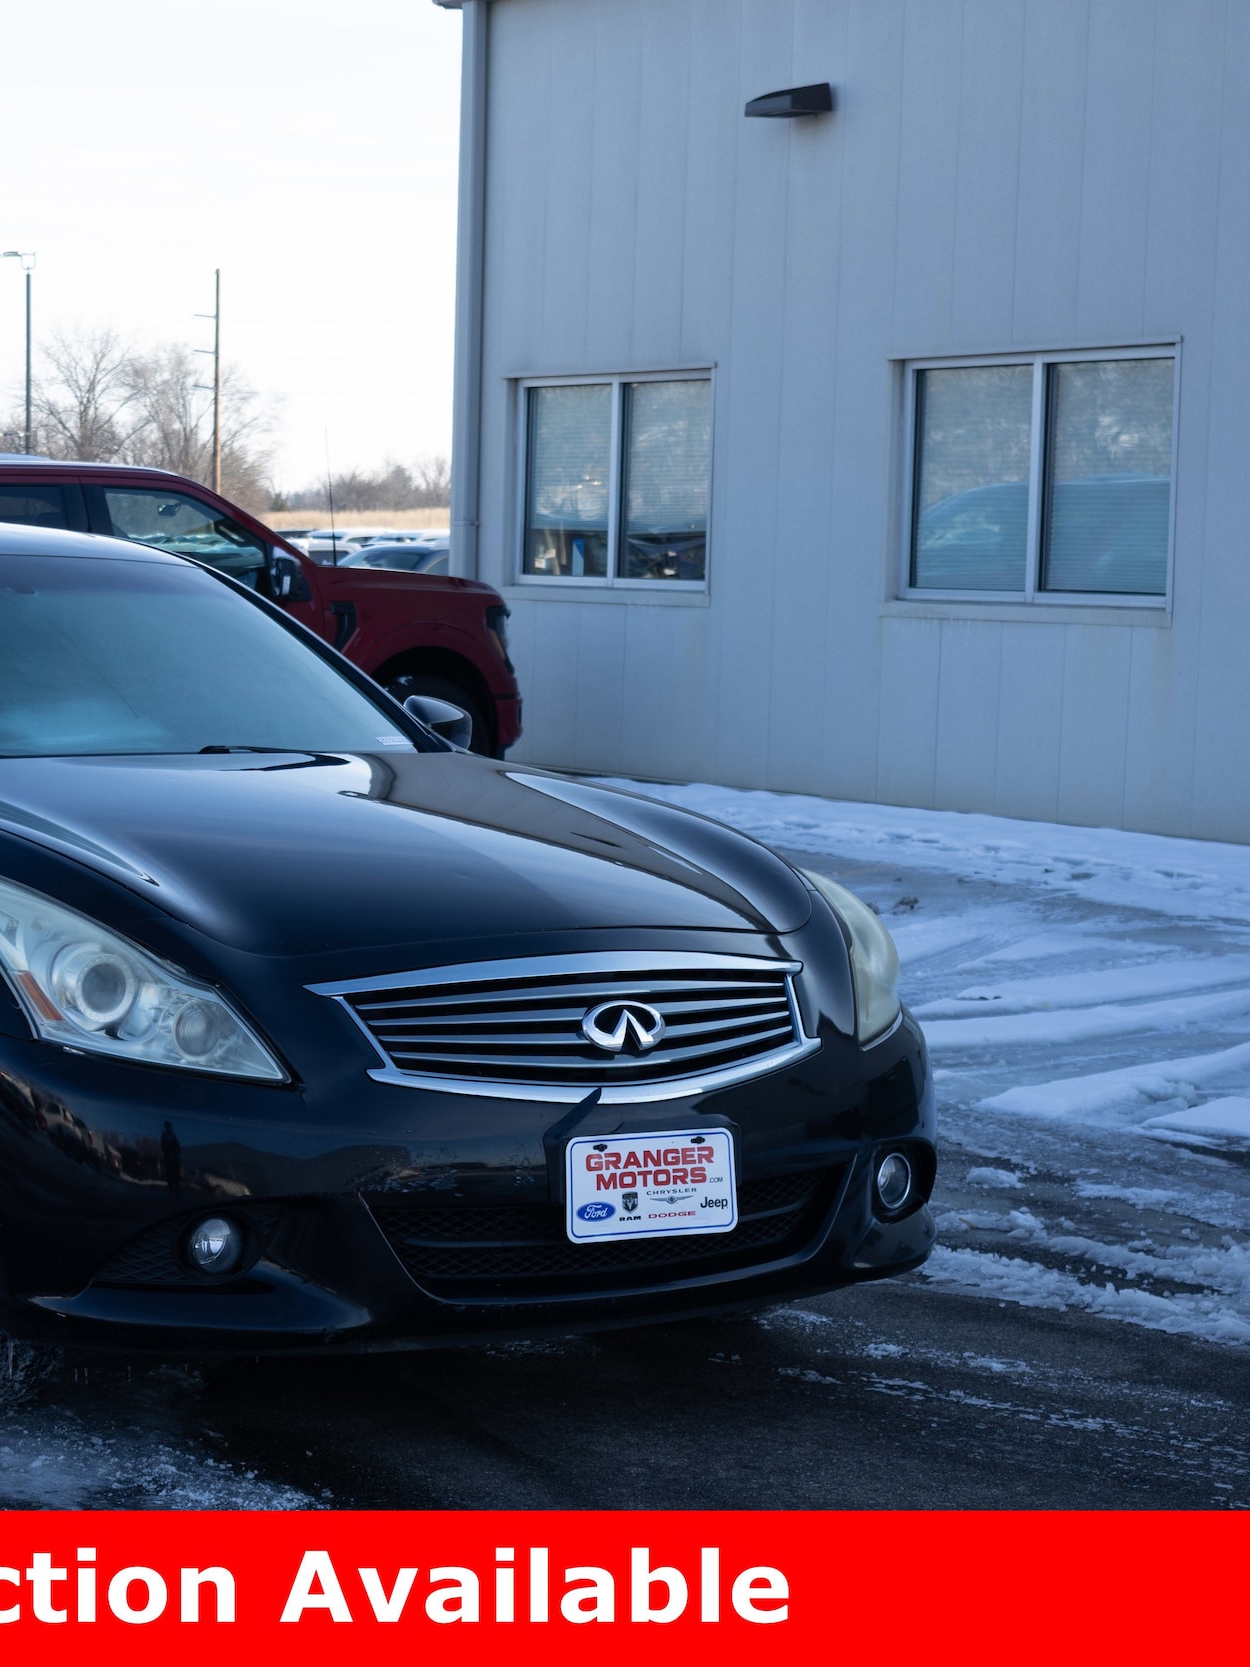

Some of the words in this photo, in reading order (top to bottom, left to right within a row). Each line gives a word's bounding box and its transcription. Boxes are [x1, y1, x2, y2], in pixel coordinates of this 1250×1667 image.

[585, 1146, 715, 1172] GRANGER
[596, 1167, 707, 1191] MOTORS
[646, 1187, 697, 1196] CHRYSLER
[700, 1196, 728, 1210] Jeep
[584, 1203, 608, 1219] Ford
[648, 1210, 696, 1219] DODGE
